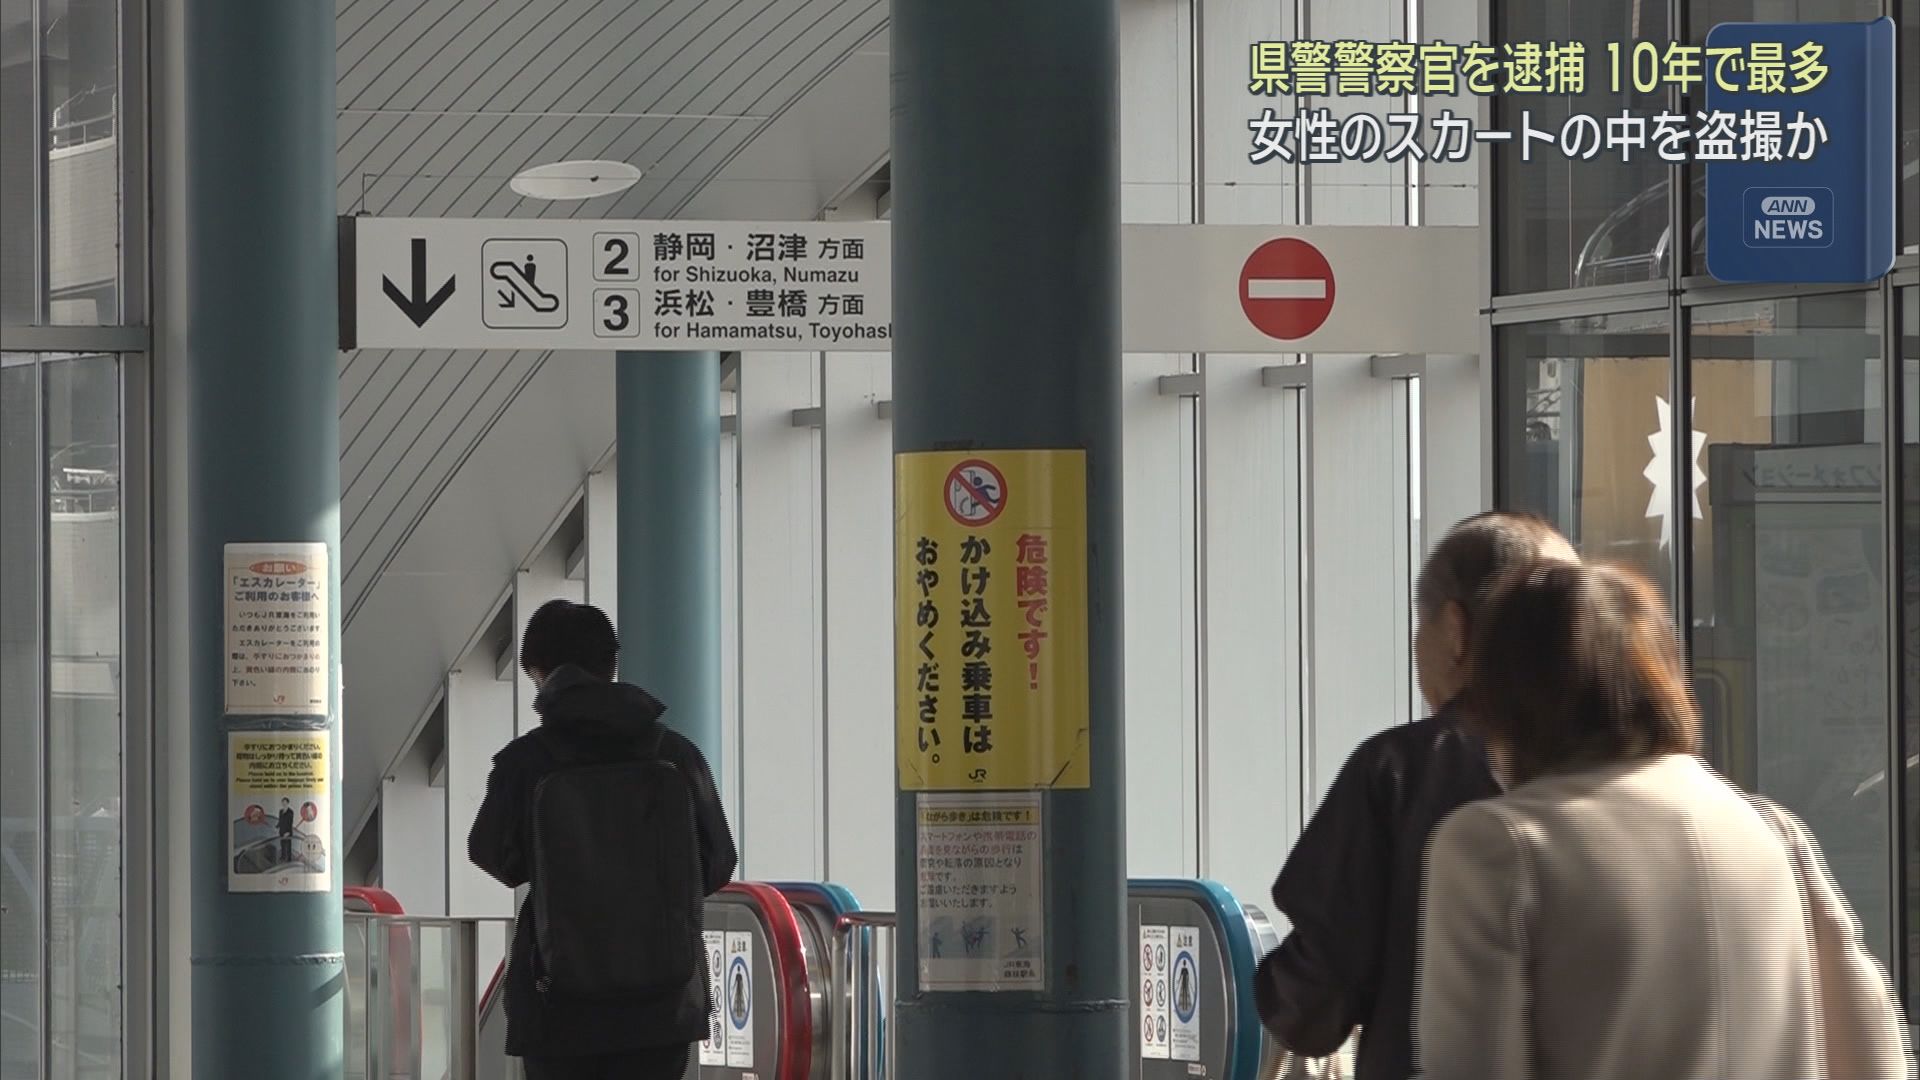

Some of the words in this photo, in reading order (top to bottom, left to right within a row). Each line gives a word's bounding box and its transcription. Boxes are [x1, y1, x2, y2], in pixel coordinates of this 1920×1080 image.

[603, 238, 630, 275] 2
[817, 238, 865, 261] 方面
[653, 266, 681, 282] for
[685, 265, 777, 285] Shizuoka,
[784, 266, 859, 283] Numazu
[603, 294, 630, 331] 3
[817, 294, 865, 316] 方面
[654, 322, 681, 338] for
[686, 322, 803, 342] Hamamatsu,
[234, 591, 319, 602] ご利用のお客様へ
[915, 536, 941, 764] おやめください。
[960, 535, 993, 754] かけ込み乗車は
[968, 768, 987, 780] JR
